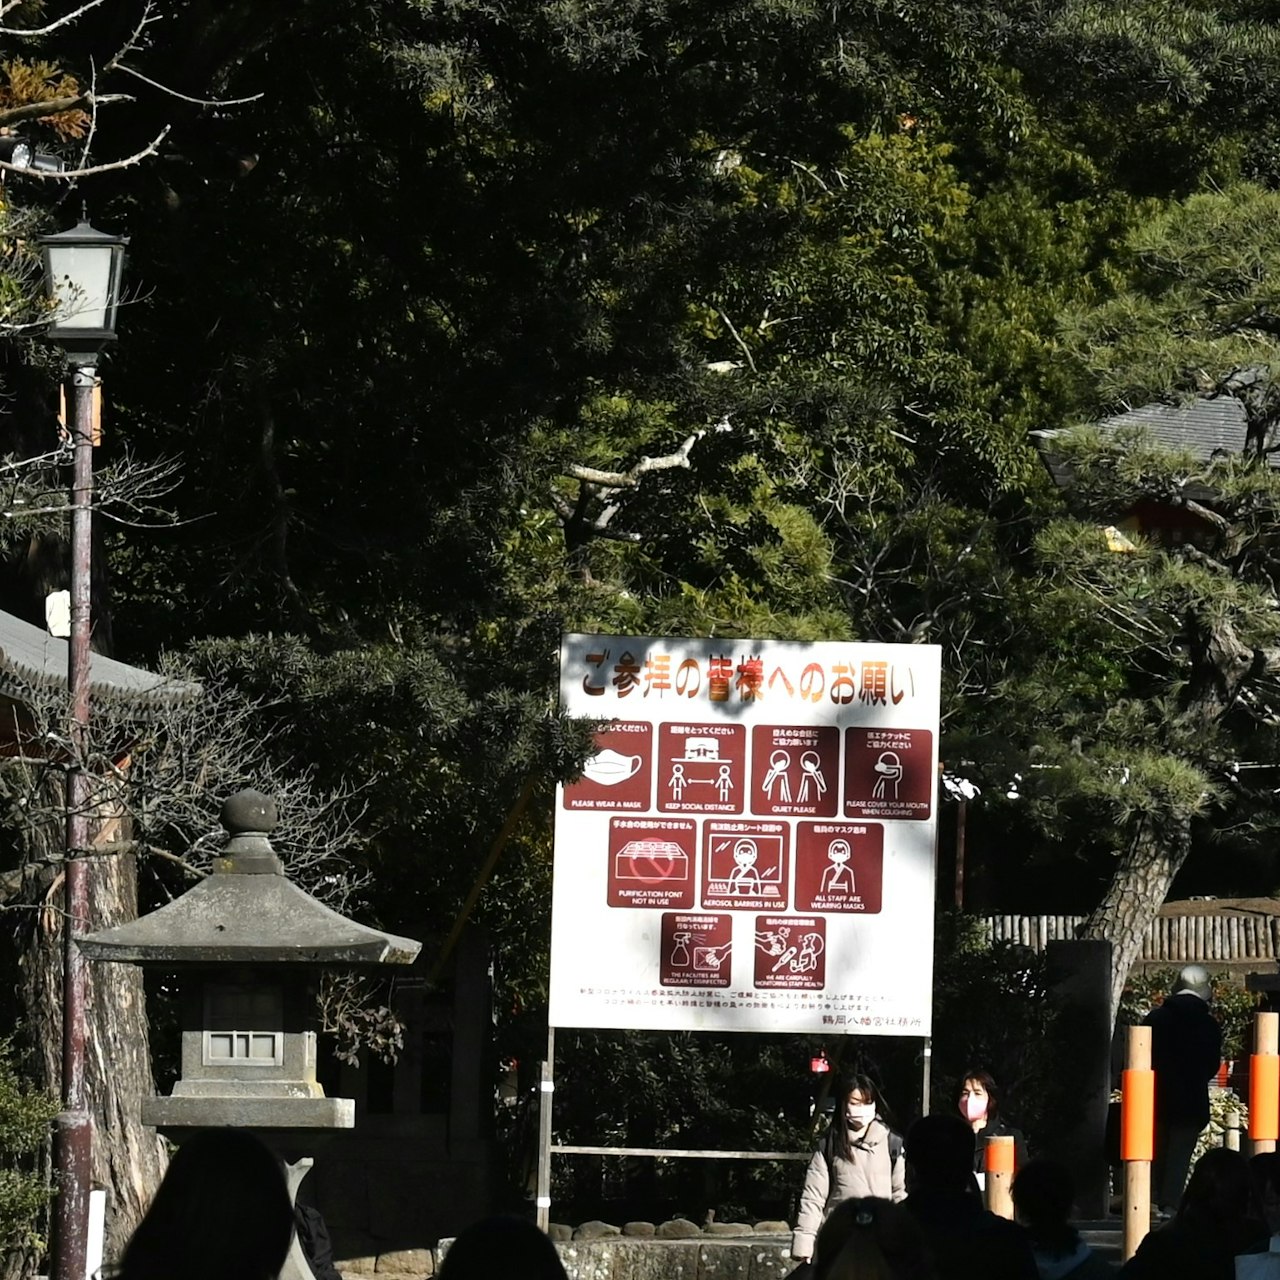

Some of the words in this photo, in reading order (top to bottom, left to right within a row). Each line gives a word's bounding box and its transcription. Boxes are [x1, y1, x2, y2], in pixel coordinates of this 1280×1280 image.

[583, 649, 915, 707] ご参拝の皆様へのお願い
[771, 805, 792, 813] QUIET
[793, 806, 816, 814] PLEASE
[703, 899, 732, 907] AEROSOL
[822, 1015, 922, 1027] 鶴岡八幡宮社務所
